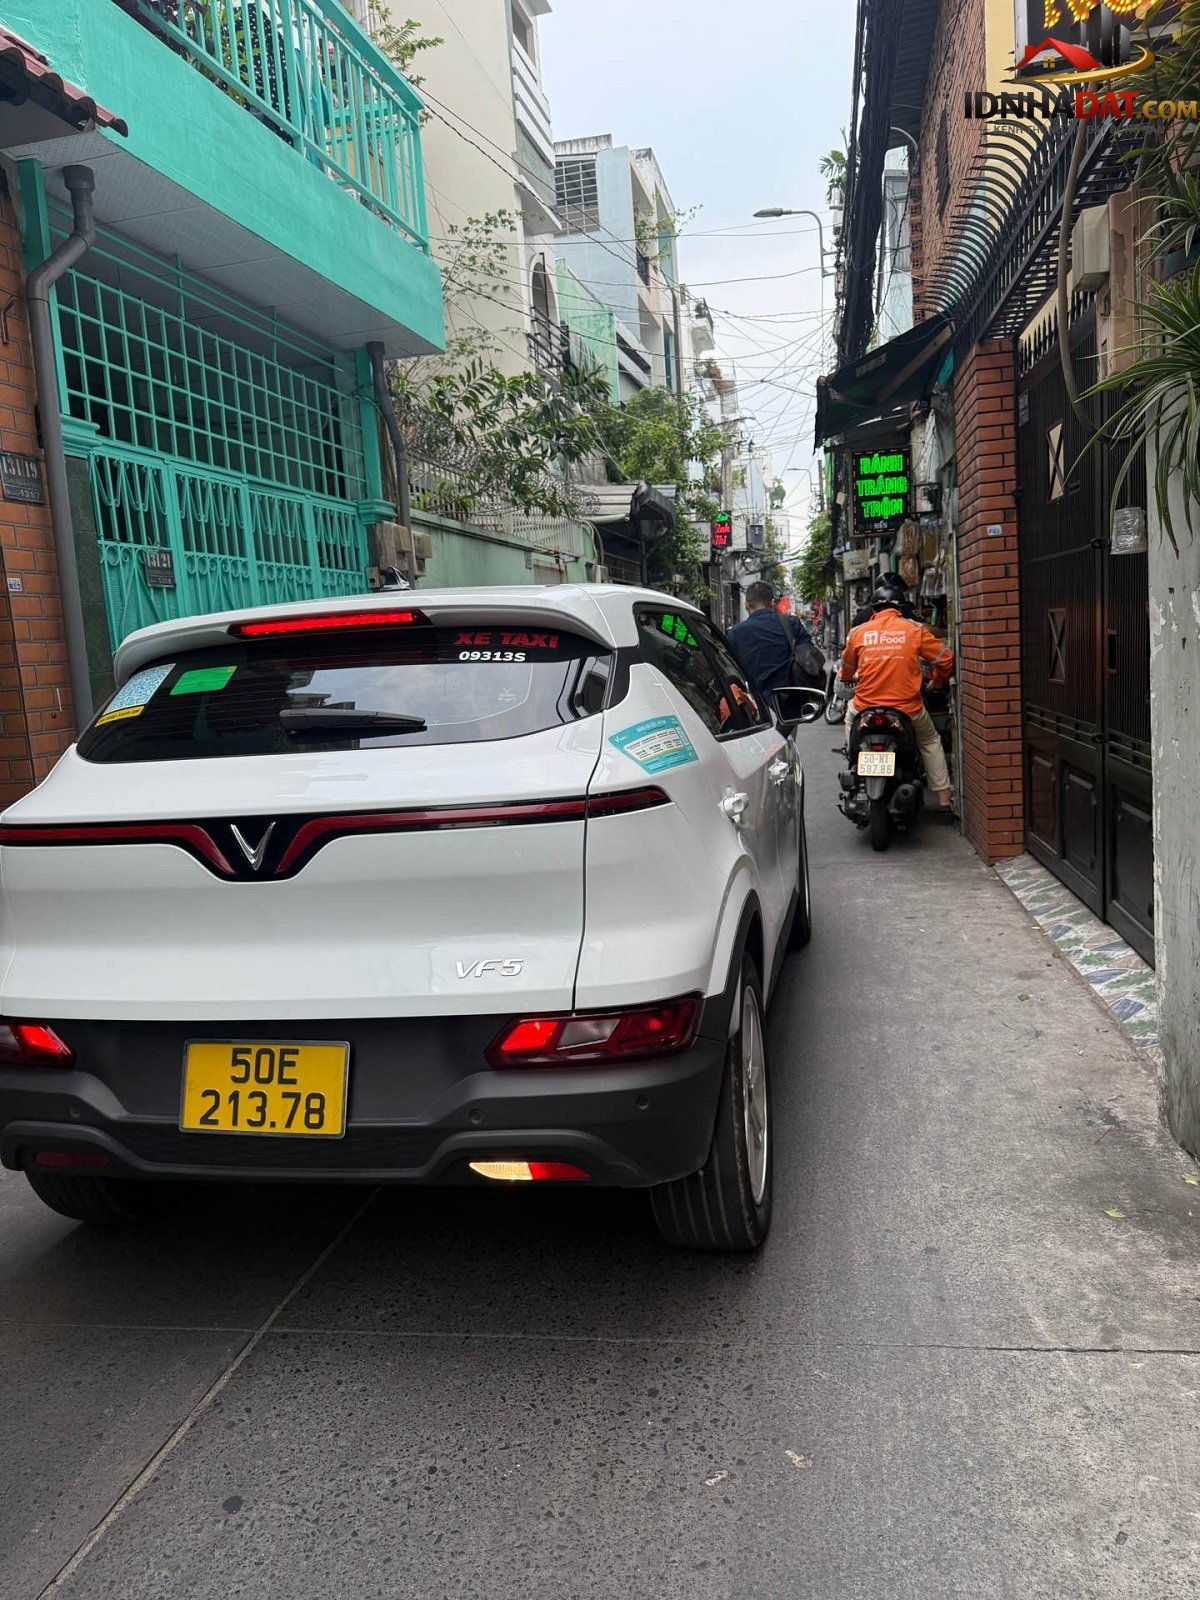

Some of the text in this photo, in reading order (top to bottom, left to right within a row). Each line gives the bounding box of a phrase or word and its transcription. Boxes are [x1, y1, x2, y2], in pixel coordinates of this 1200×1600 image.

[860, 453, 903, 474] BÁNH
[856, 475, 908, 496] TRÁNG
[861, 497, 903, 519] TRỘN
[454, 632, 559, 649] XE TAXI
[880, 635, 906, 644] Food
[458, 651, 527, 662] 09313S
[455, 958, 524, 979] VF5
[230, 1047, 299, 1085] 50E
[199, 1089, 326, 1130] 213.78
